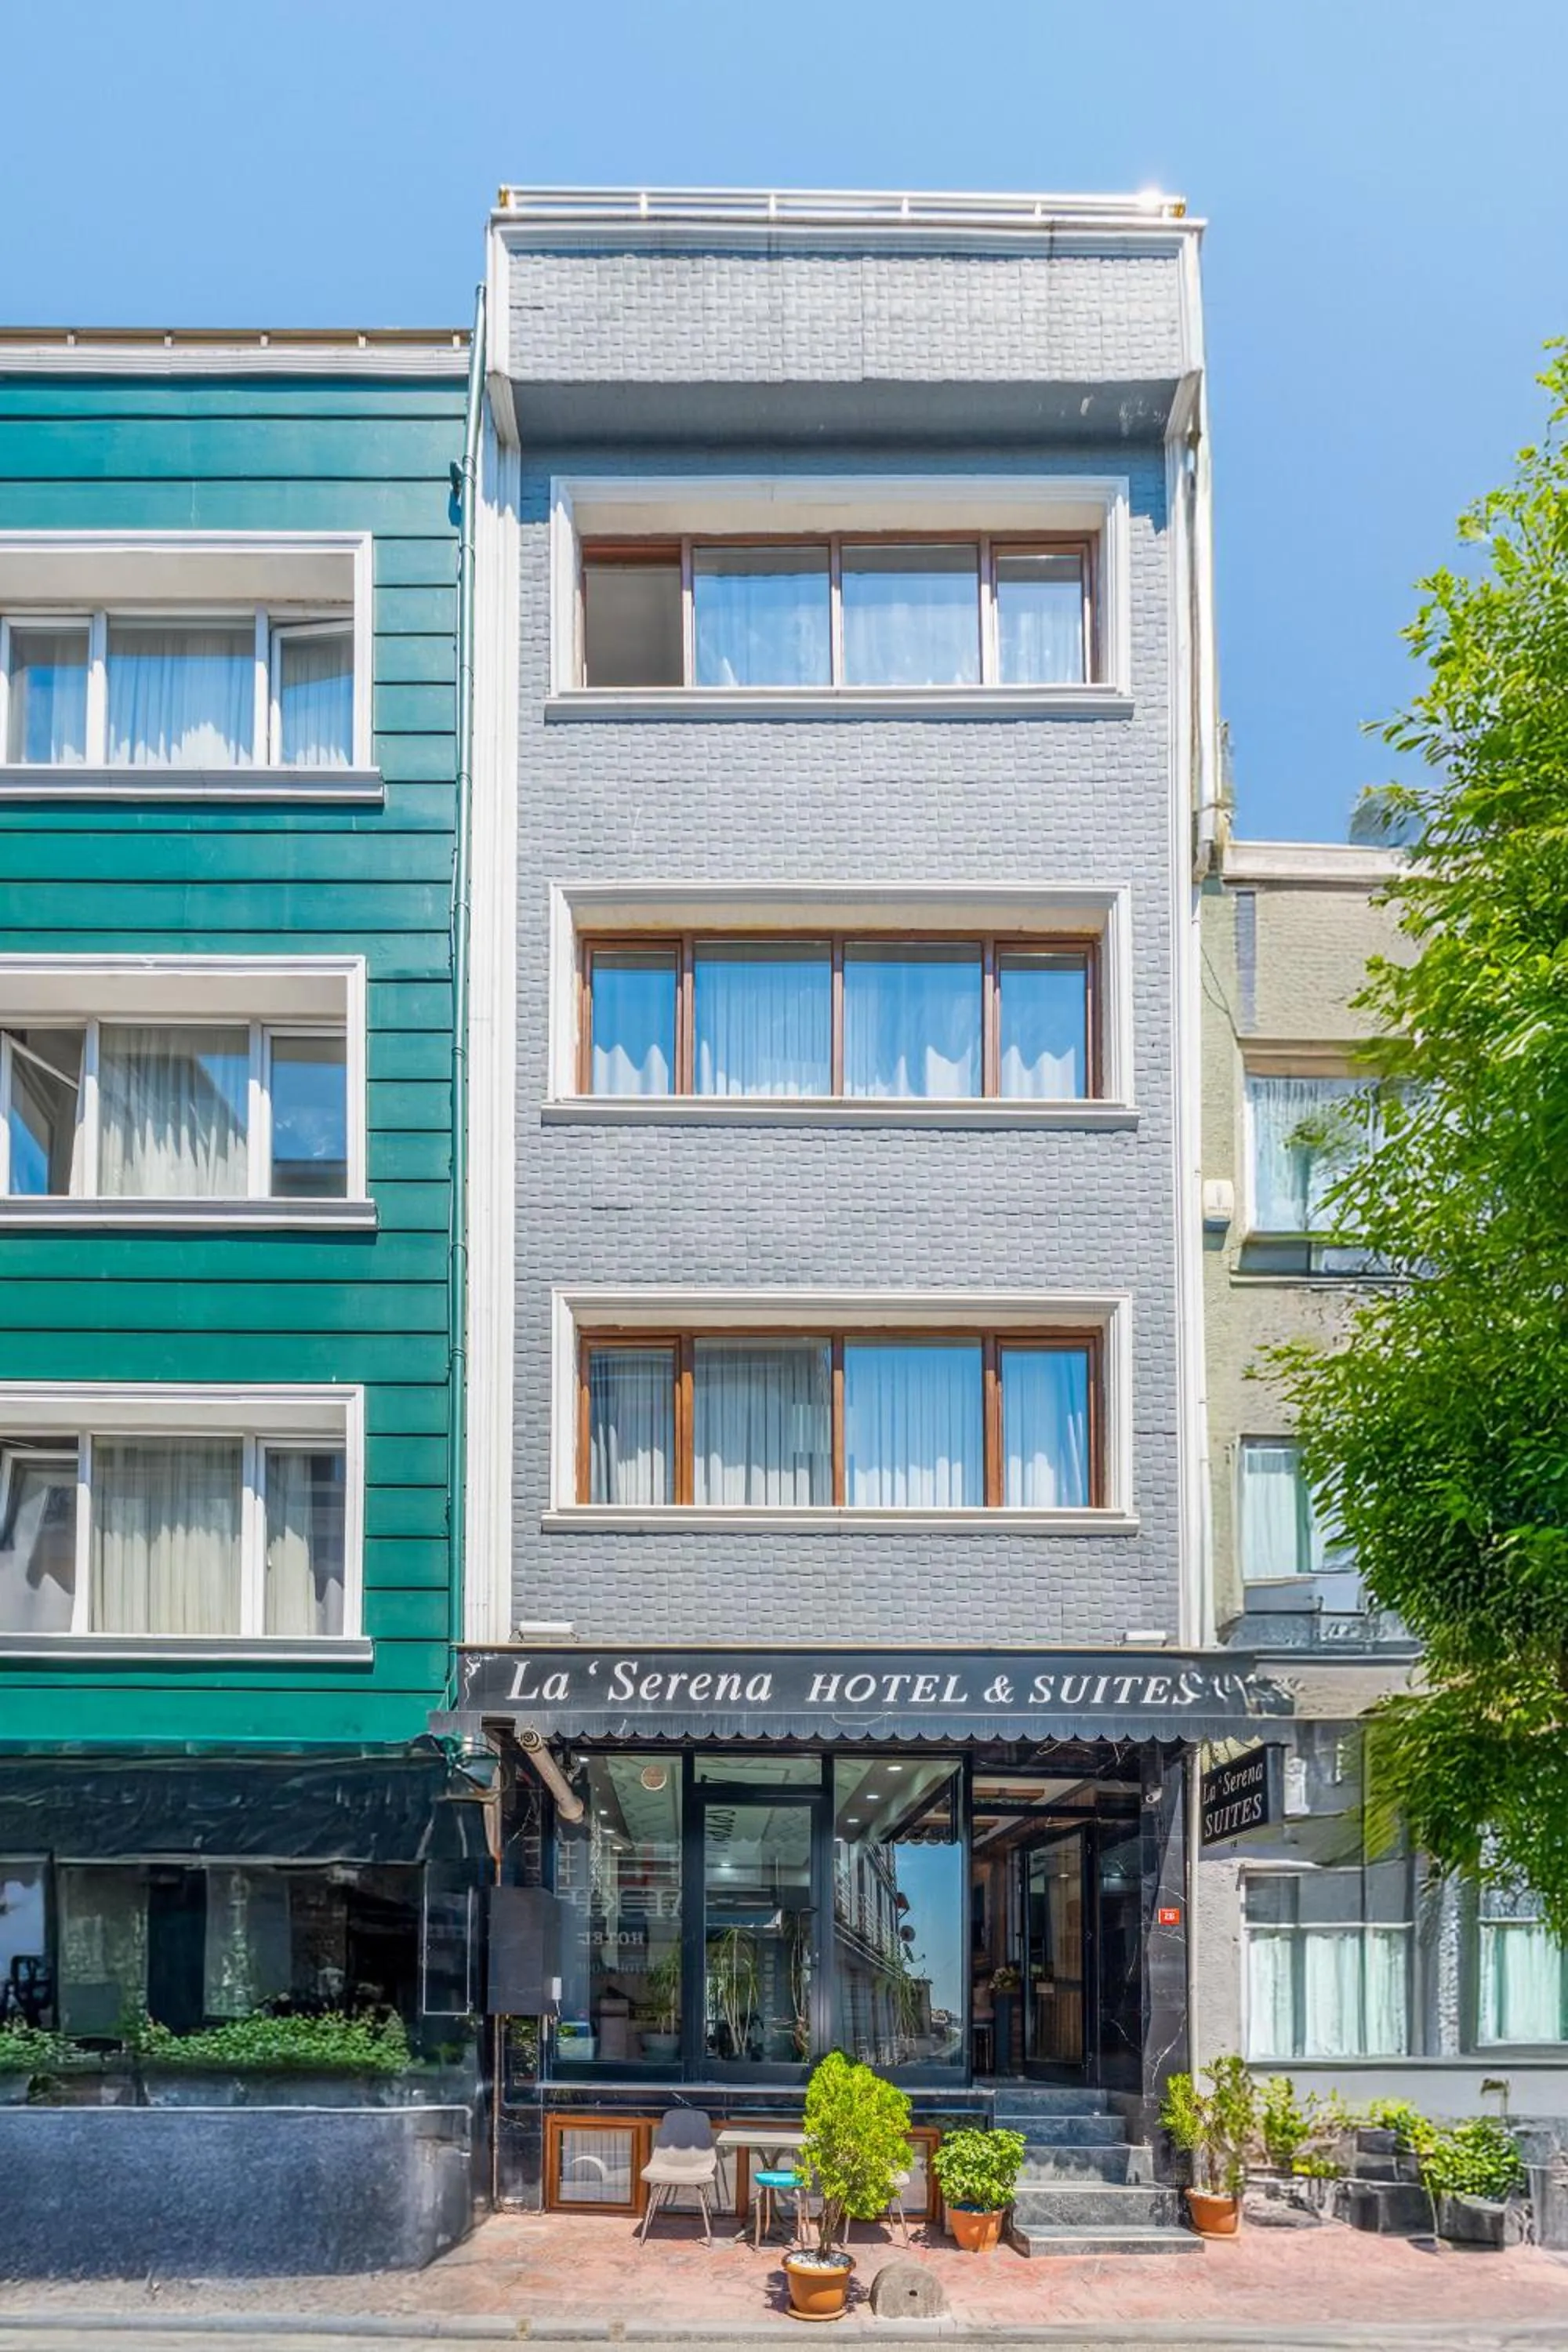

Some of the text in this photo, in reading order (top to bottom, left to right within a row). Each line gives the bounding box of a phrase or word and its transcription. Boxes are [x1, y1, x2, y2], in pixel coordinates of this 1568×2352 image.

[506, 1661, 569, 1700] La
[805, 1674, 968, 1703] HOTEL
[983, 1674, 1014, 1703] &
[1028, 1675, 1202, 1704] SUITES
[1203, 1784, 1216, 1805] La
[1204, 1793, 1262, 1837] SUITES
